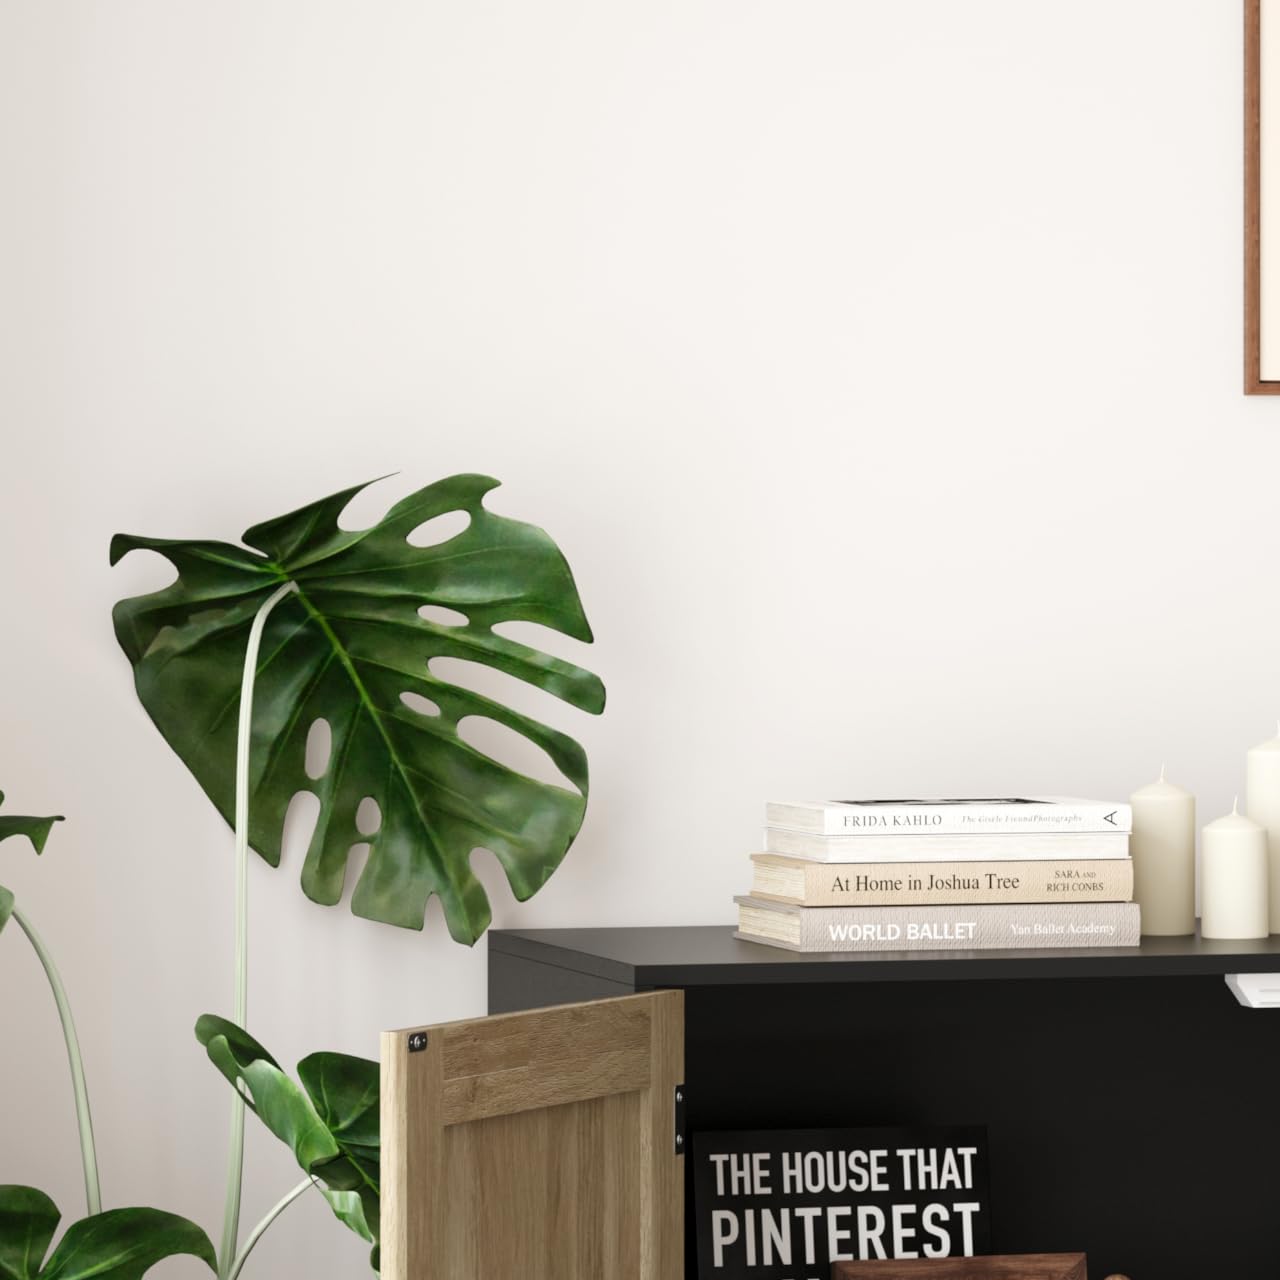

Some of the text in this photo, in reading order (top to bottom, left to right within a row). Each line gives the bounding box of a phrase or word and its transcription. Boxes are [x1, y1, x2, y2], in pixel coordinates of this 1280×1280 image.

[843, 814, 942, 827] FRIDA KAHLO
[831, 873, 1021, 892] At Home in Joshua Tree
[1054, 870, 1081, 879] SARA
[1046, 882, 1070, 892] RICH
[828, 922, 977, 942] WORLD BALLET
[1067, 921, 1117, 936] Academy
[709, 1147, 977, 1196] THE HOUSE THAT
[711, 1202, 981, 1268] PINTEREST
